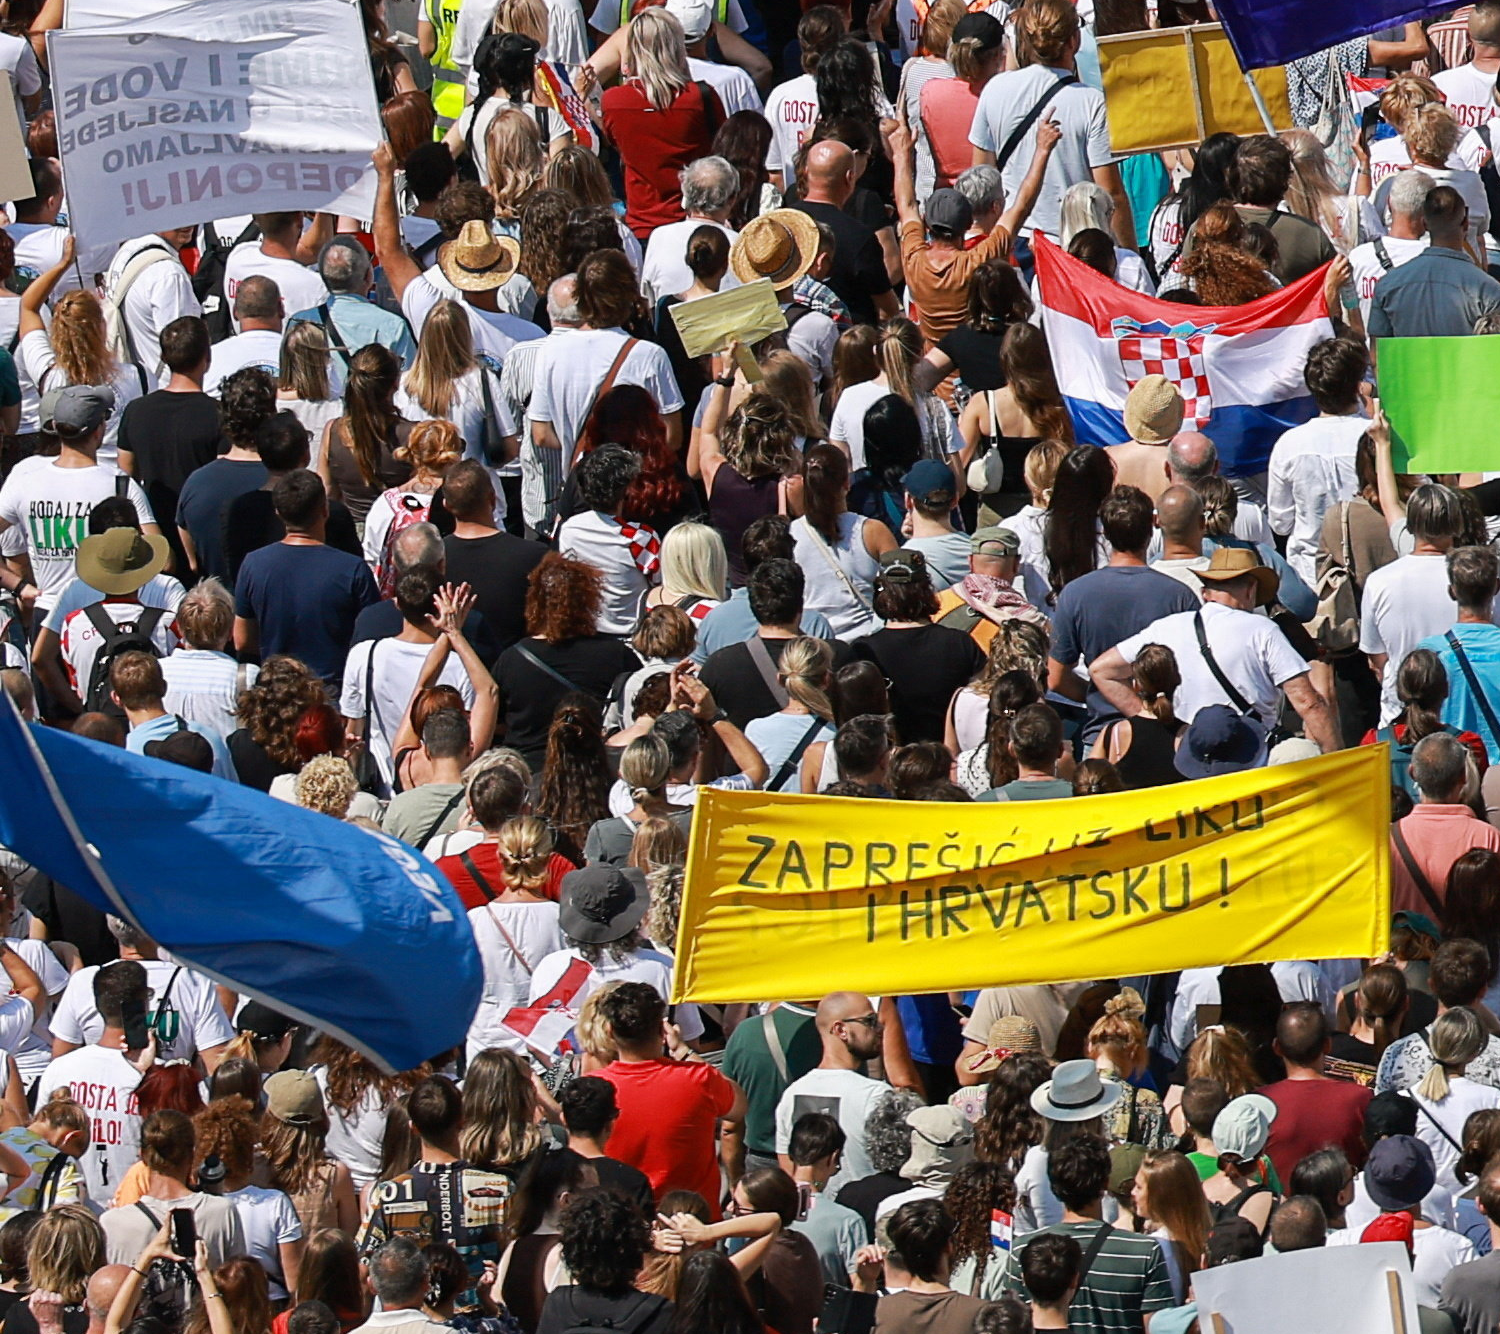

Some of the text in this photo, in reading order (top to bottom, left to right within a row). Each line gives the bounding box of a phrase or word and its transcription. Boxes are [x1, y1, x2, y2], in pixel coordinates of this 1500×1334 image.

[738, 793, 1266, 889] ZAPREŠIĆ LIKU
[898, 870, 1191, 943] HRVATSKU
